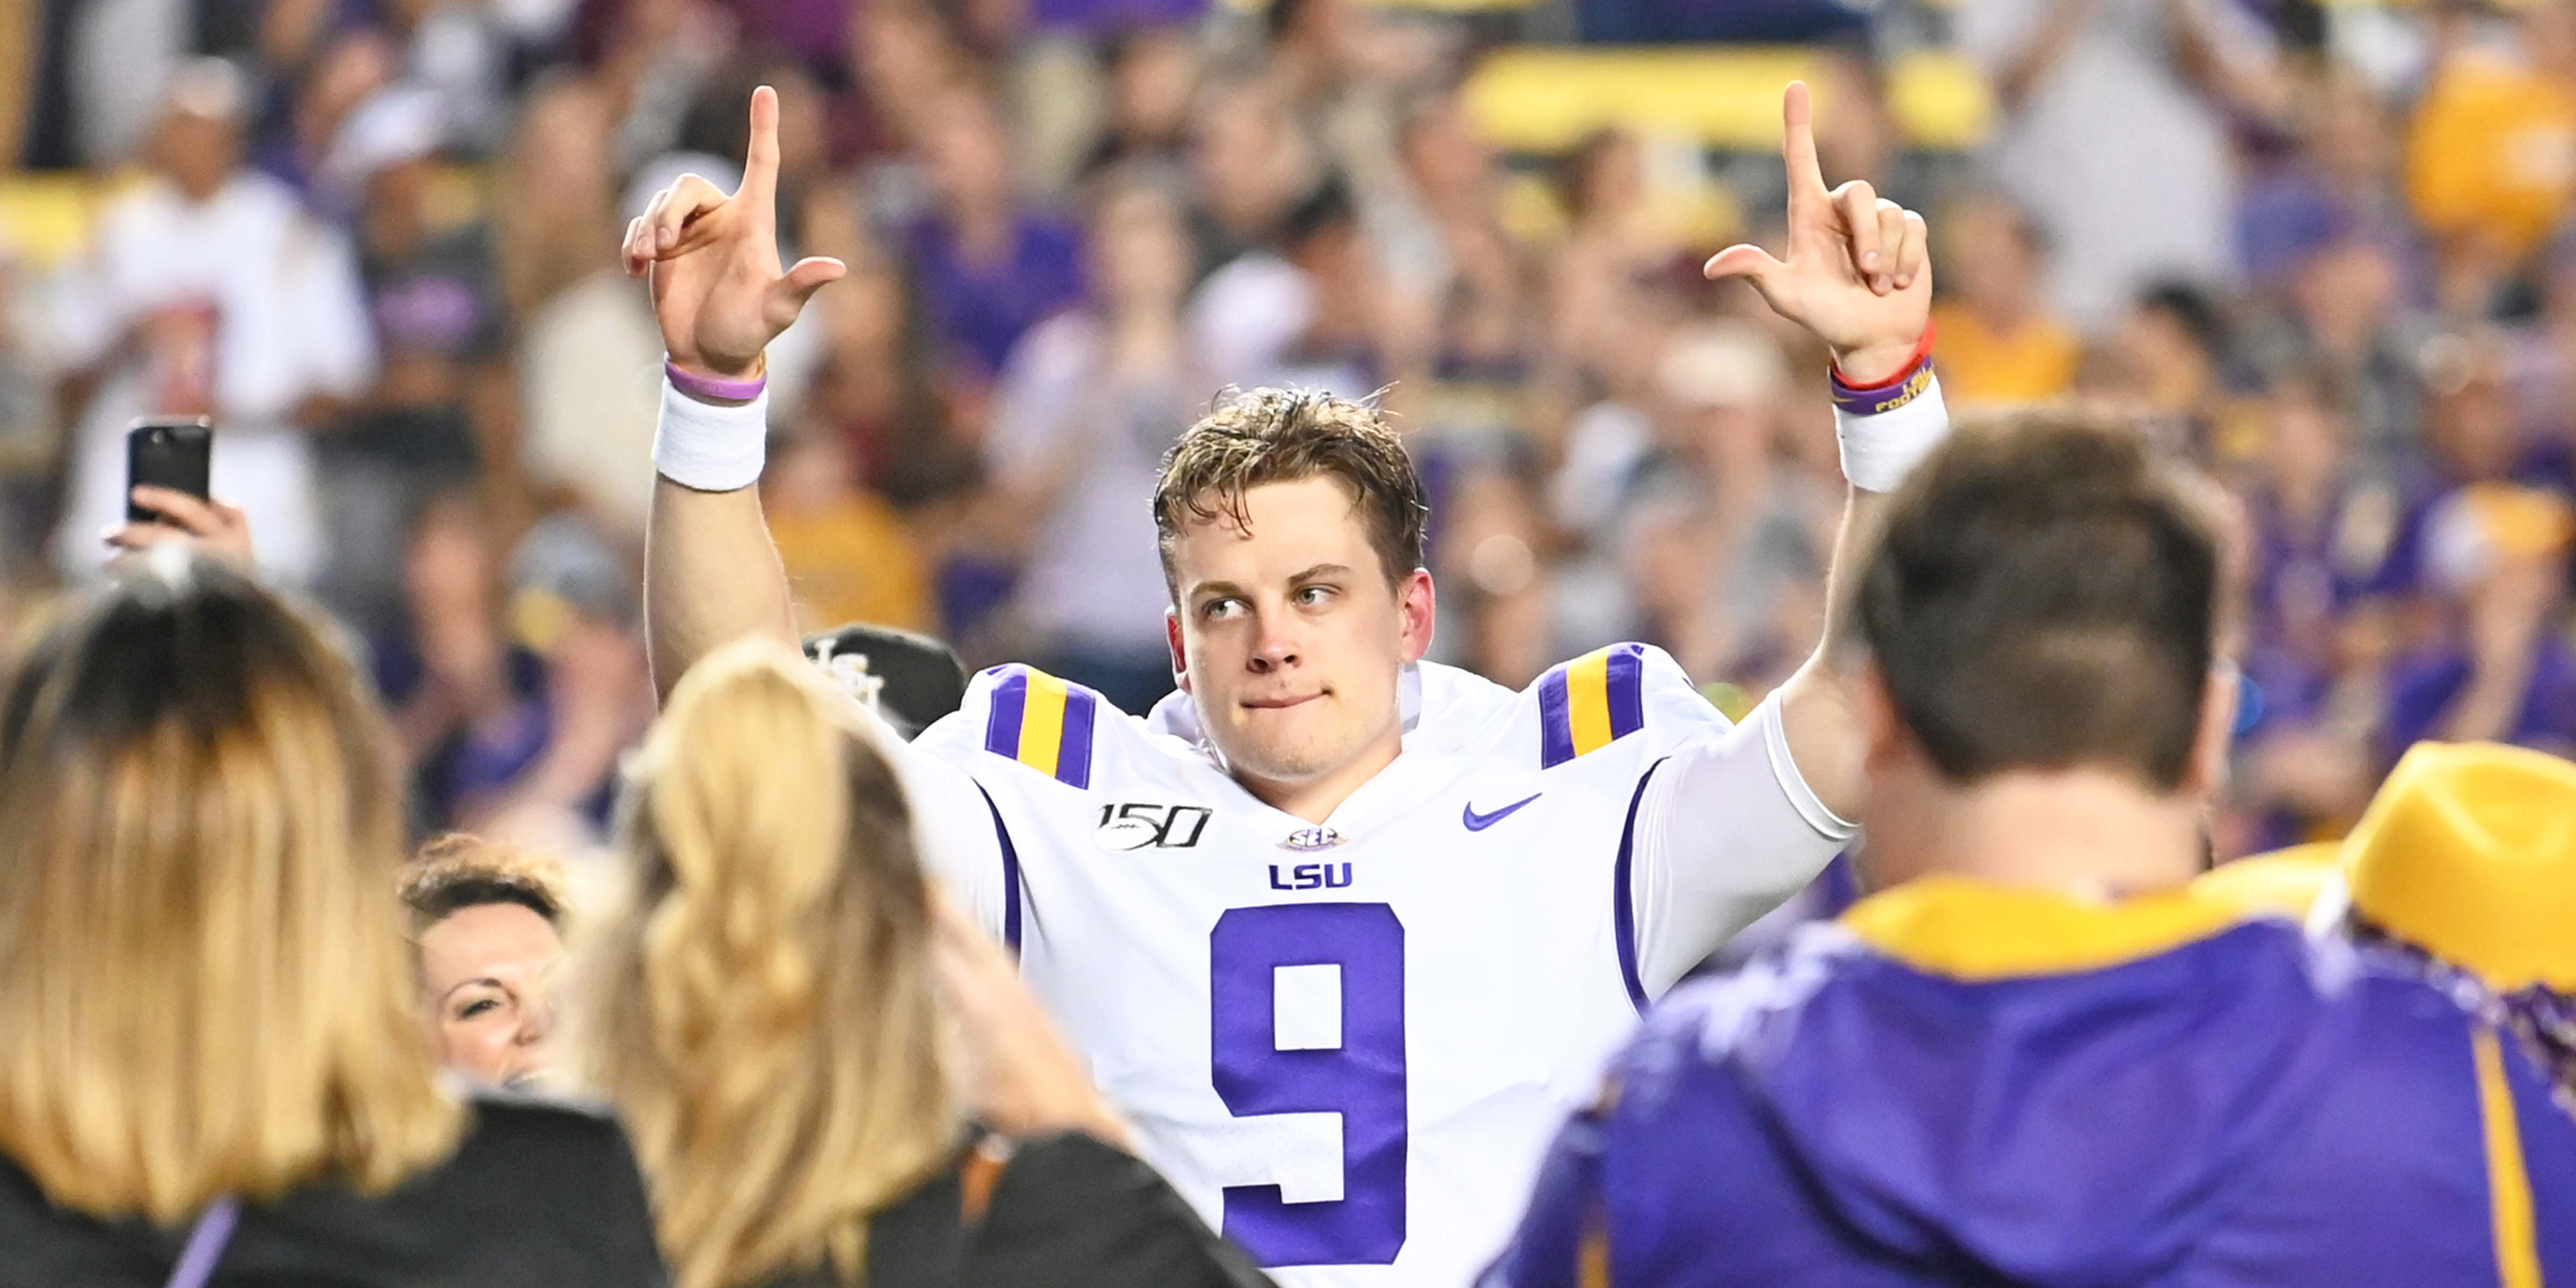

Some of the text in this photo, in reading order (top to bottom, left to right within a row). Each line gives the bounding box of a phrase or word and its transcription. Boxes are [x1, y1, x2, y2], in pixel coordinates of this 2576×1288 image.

[1099, 803, 1213, 851] 150
[1289, 828, 1338, 846] SEC
[1269, 862, 1353, 890] LSU
[1211, 902, 1408, 1268] 9
